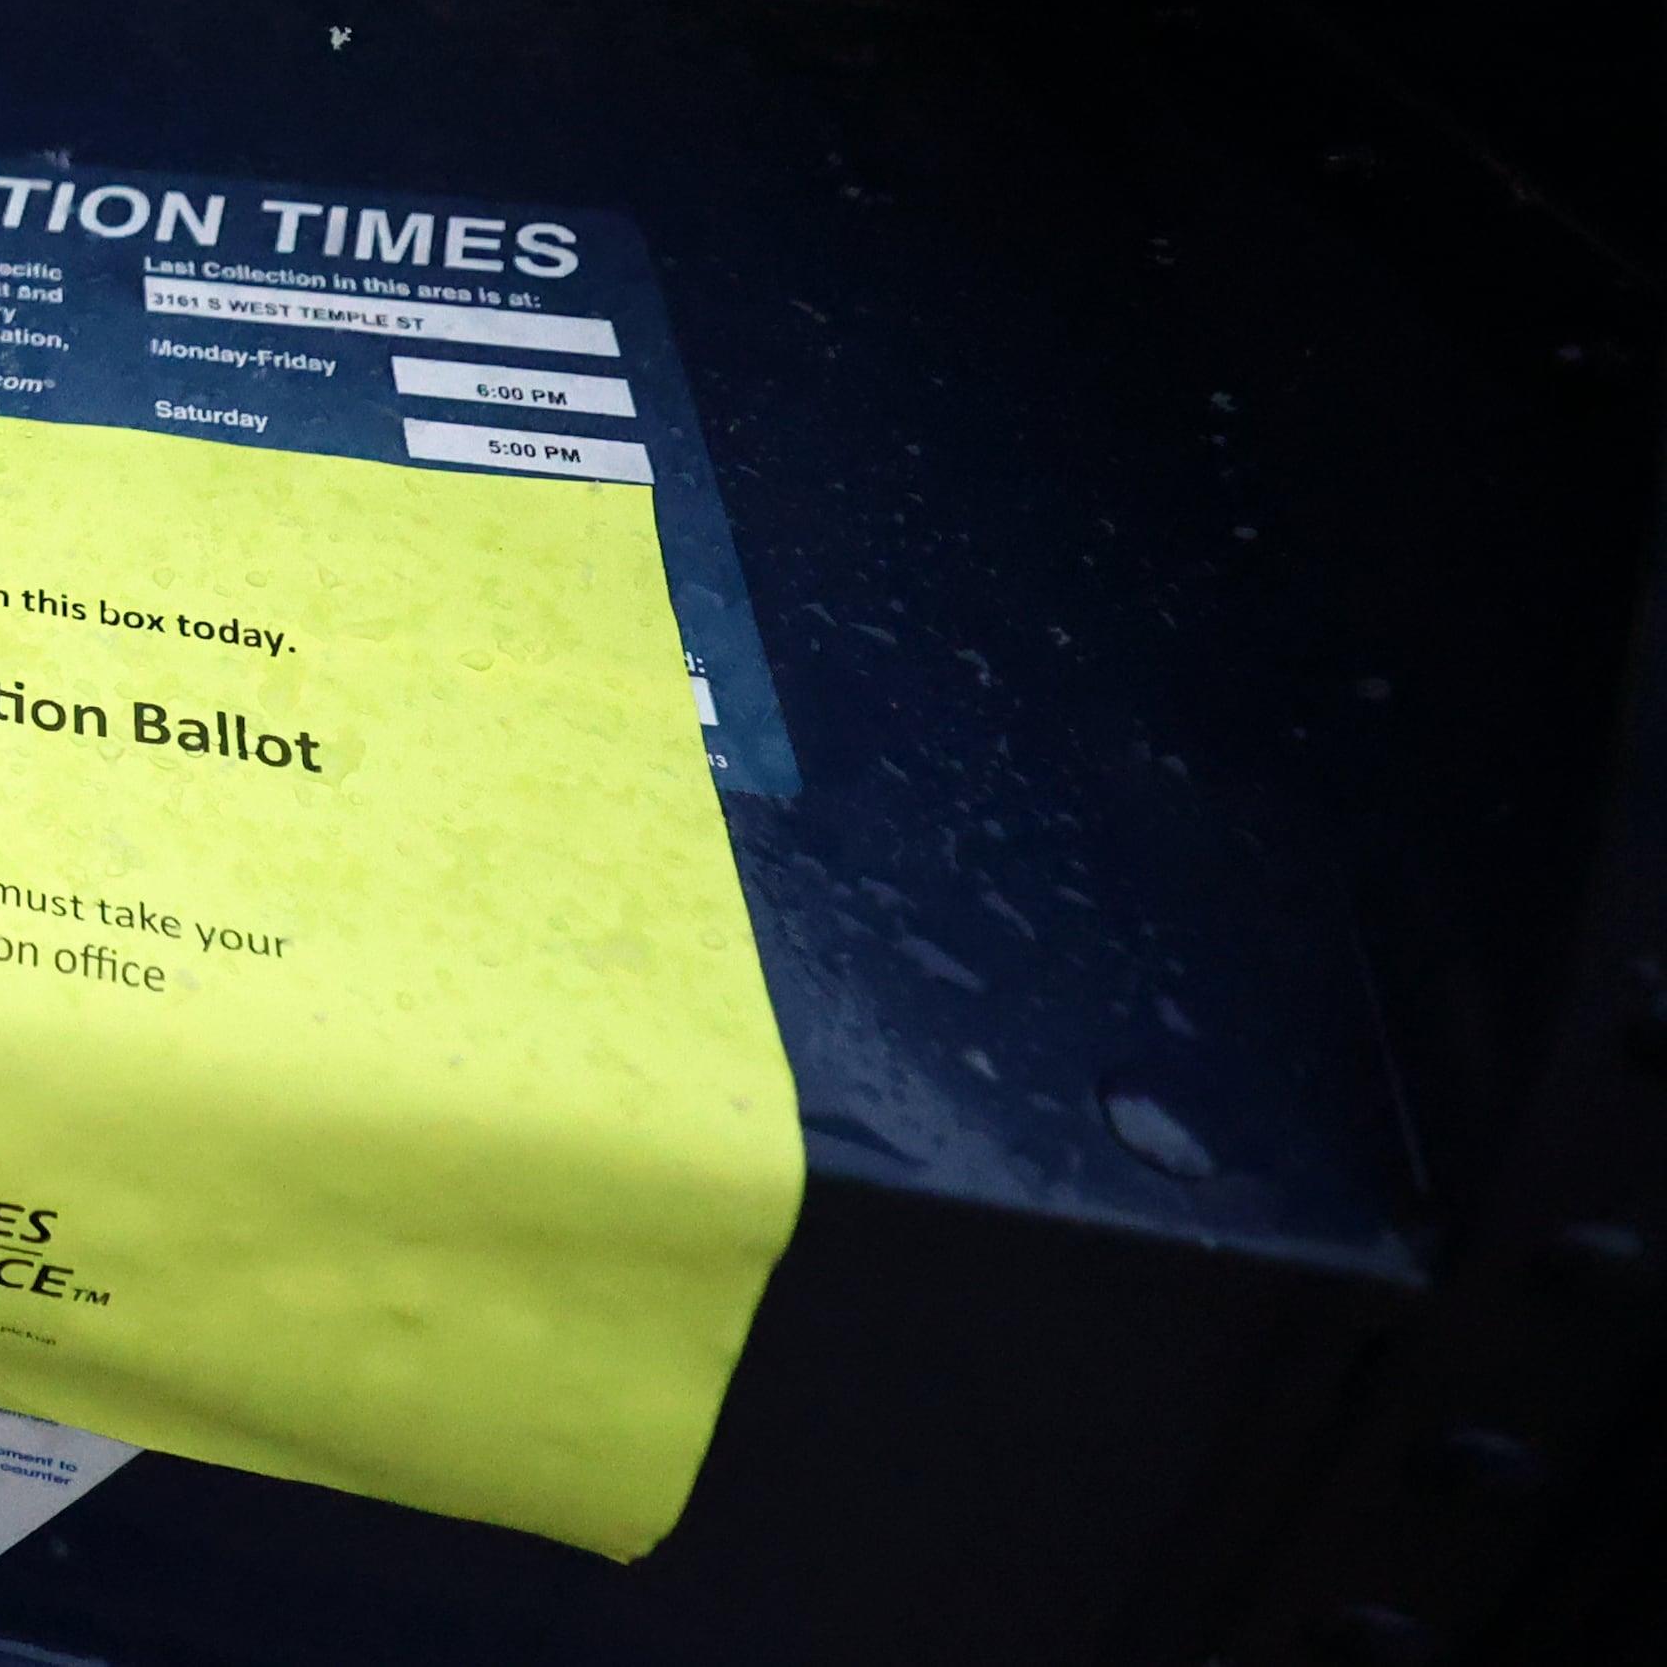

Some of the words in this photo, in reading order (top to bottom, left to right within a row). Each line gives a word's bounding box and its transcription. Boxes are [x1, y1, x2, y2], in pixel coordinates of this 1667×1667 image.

[261, 198, 581, 281] TIMES
[17, 285, 64, 304] and
[143, 256, 196, 277] Last
[201, 260, 327, 289] Collection
[333, 272, 357, 293] in
[364, 275, 410, 297] this
[417, 283, 473, 302] area
[478, 287, 501, 306] is
[508, 290, 542, 310] at:
[151, 292, 200, 310] 3161
[207, 295, 222, 311] S
[228, 298, 291, 318] WEST
[299, 305, 389, 328] TEMPLE
[396, 315, 425, 332] ST
[149, 338, 337, 377] Monday-Friday
[476, 383, 523, 401] 6:00
[531, 389, 568, 406] PM
[154, 399, 269, 434] Saturday
[488, 439, 536, 458] 5:00
[544, 445, 582, 464] PM
[21, 589, 87, 622] this
[99, 599, 166, 634] box
[177, 612, 298, 658] today.
[133, 700, 323, 773] Ballot
[97, 898, 183, 939] take
[195, 921, 290, 959] your
[53, 943, 166, 992] office
[0, 1461, 73, 1486] counter
[58, 1460, 78, 1474] to
